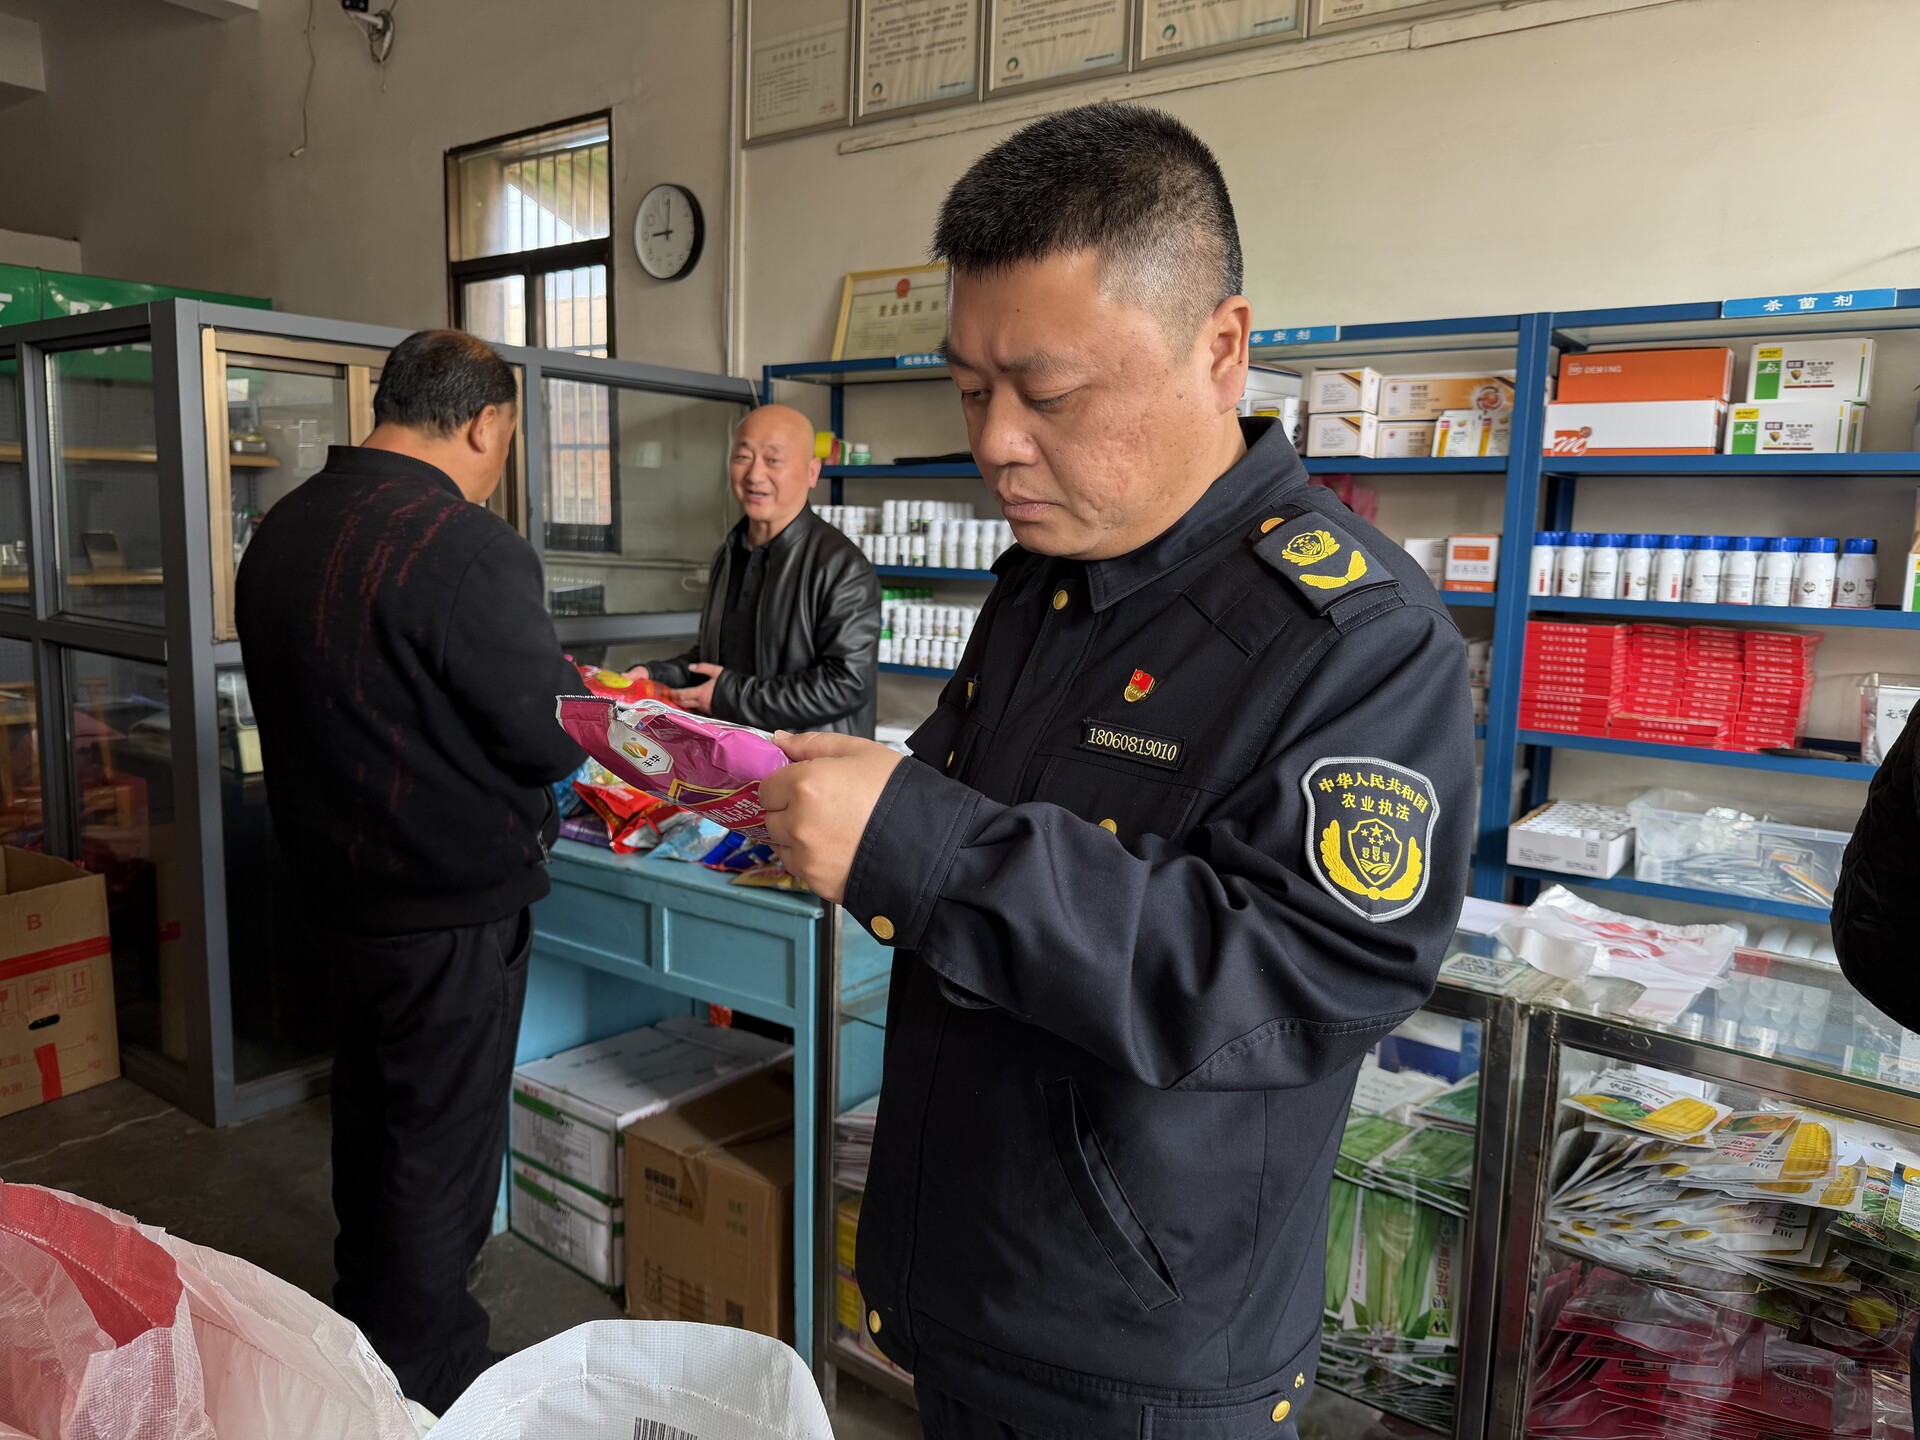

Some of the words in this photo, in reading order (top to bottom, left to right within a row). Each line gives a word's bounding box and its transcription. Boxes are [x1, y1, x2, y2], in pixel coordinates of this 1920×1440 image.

[1763, 293, 1853, 312] 杀菌剂
[1087, 727, 1178, 762] 18060819010
[1318, 772, 1429, 814] 中华人民共和国
[1341, 792, 1411, 822] 农业执法
[26, 913, 43, 931] B
